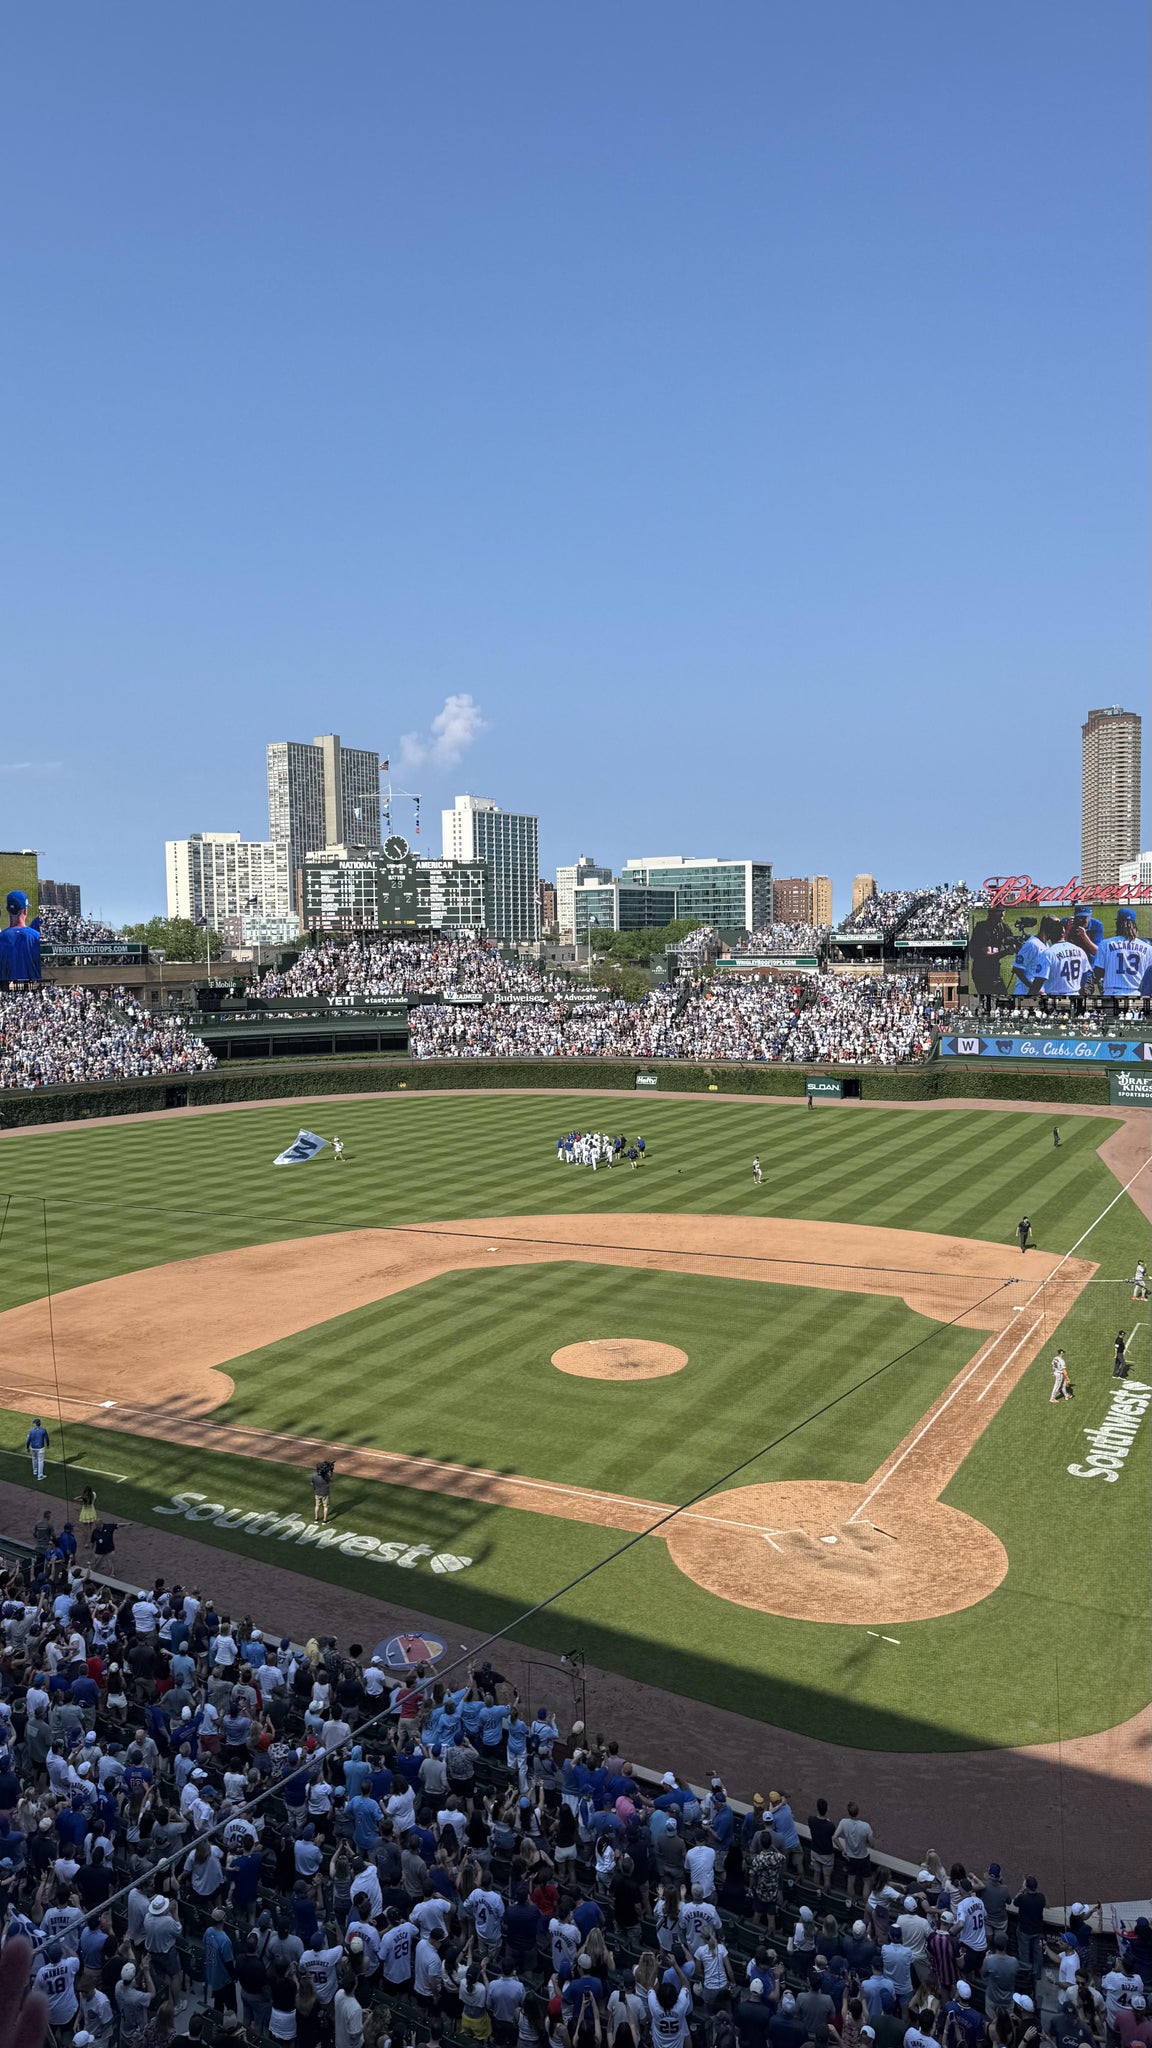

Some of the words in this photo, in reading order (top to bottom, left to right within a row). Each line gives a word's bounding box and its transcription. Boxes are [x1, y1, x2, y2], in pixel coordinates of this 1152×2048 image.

[52, 945, 128, 954] WRIGLEYROOFTOPS.COM
[1060, 959, 1081, 982] 48
[1116, 953, 1141, 976] 13
[327, 996, 355, 1006] YETI
[369, 997, 409, 1005] tastytrade
[494, 993, 546, 1003] Budweiser
[563, 993, 597, 1001] Advocate
[962, 1040, 974, 1051] W
[1020, 1041, 1040, 1056] Go,
[637, 1077, 656, 1085] Hefty
[807, 1083, 840, 1091] SLOAN
[283, 1138, 318, 1159] W
[1067, 1389, 1152, 1483] Southwest
[152, 1491, 435, 1569] Southwest
[972, 1913, 984, 1931] 16
[394, 1940, 409, 1960] 29
[47, 1977, 66, 1995] 18
[659, 2020, 679, 2034] 25
